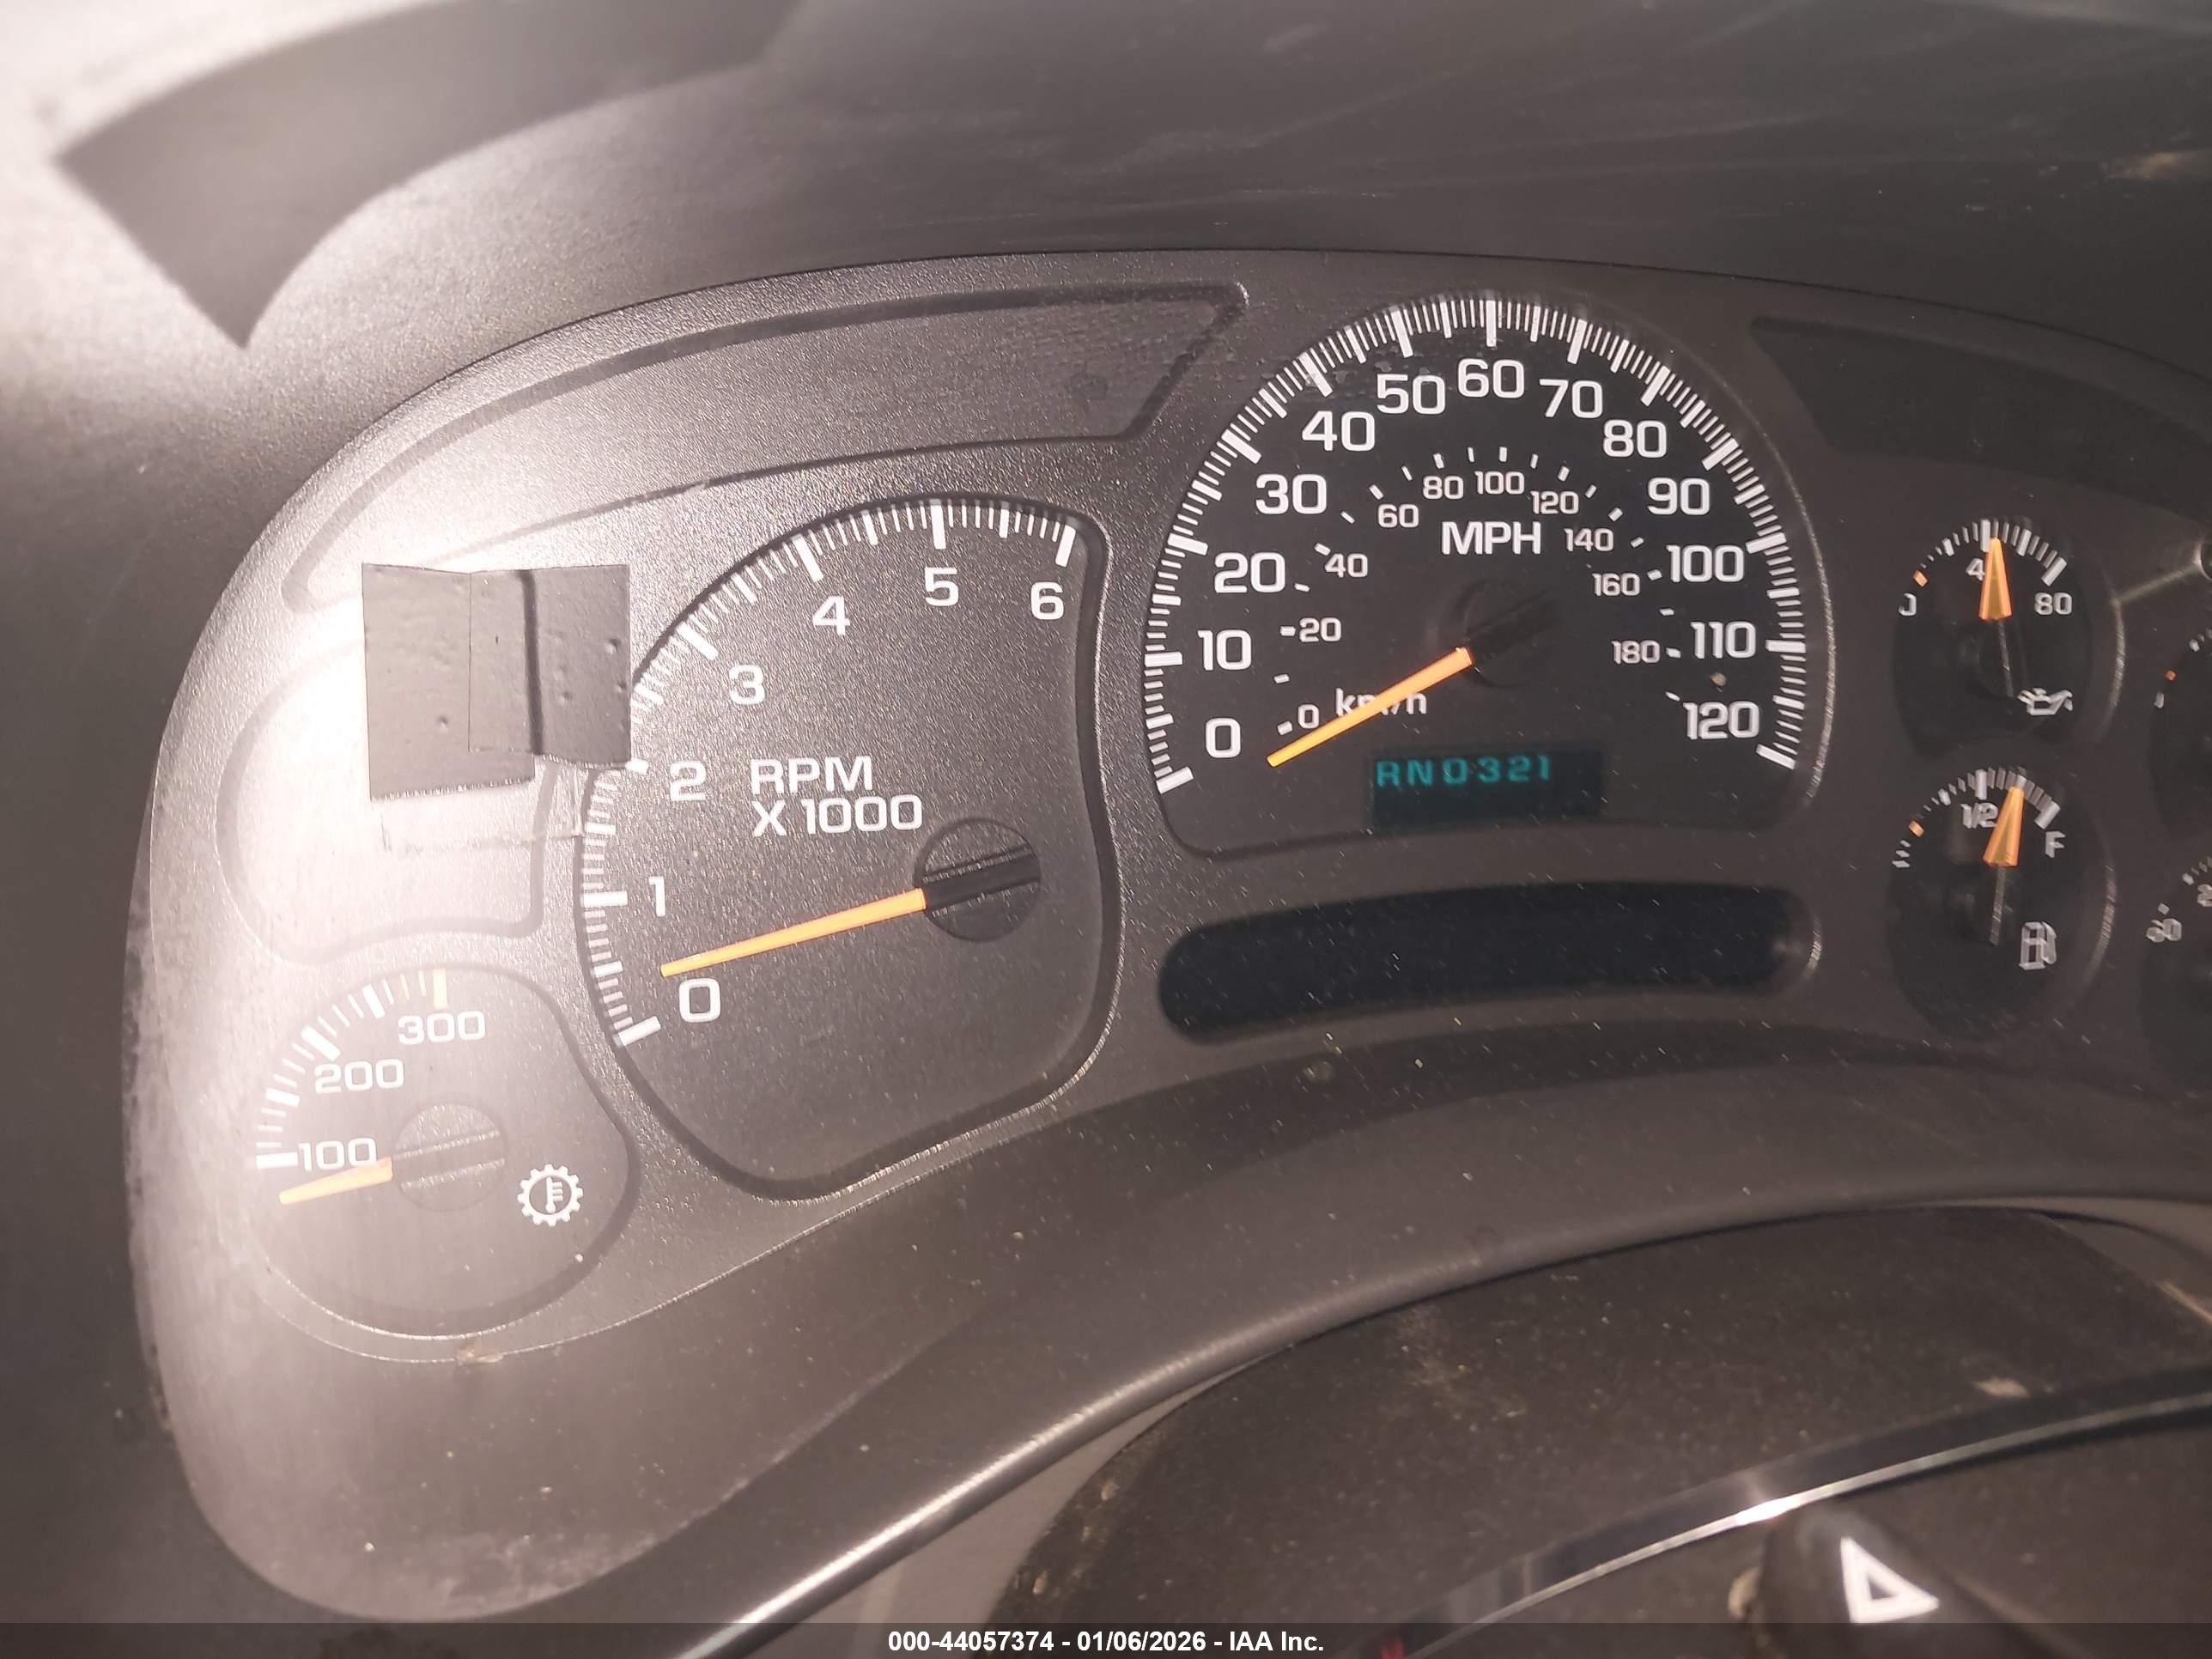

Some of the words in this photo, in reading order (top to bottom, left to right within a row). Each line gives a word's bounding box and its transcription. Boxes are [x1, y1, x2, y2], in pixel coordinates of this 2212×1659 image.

[1376, 374, 1445, 415] 50
[1457, 359, 1525, 399] 60
[1539, 379, 1602, 418] 70
[1301, 410, 1375, 451] 40
[1603, 419, 1667, 459] 80
[1255, 474, 1327, 515] 30
[1423, 474, 1464, 501] 80
[1474, 471, 1525, 496] 100
[1530, 489, 1579, 515] 120
[1648, 477, 1711, 516] 90
[1377, 504, 1419, 528] 60
[1441, 520, 1540, 555] MPH
[1564, 527, 1613, 552] 140
[1214, 552, 1285, 594] 20
[1325, 552, 1368, 579] 40
[1666, 545, 1746, 584] 100
[924, 567, 959, 606] 5
[1030, 581, 1065, 620] 6
[1593, 573, 1640, 598] 160
[2034, 592, 2072, 615] 80
[811, 596, 850, 635] 4
[1298, 617, 1341, 642] 20
[1197, 629, 1252, 671] 10
[1612, 641, 1660, 664] 180
[1691, 621, 1756, 659] 110
[729, 664, 766, 705] 3
[1298, 703, 1319, 730] 0
[1683, 701, 1760, 739] 120
[1205, 718, 1242, 759] 0
[669, 762, 706, 801] 2
[750, 755, 873, 795] RPM
[752, 801, 787, 836] X
[801, 794, 923, 834] 1000
[2045, 831, 2065, 858] F
[648, 876, 666, 916] 1
[678, 977, 720, 1023] 0
[398, 1011, 486, 1045] 300
[315, 1059, 404, 1093] 200
[299, 1138, 377, 1171] 100
